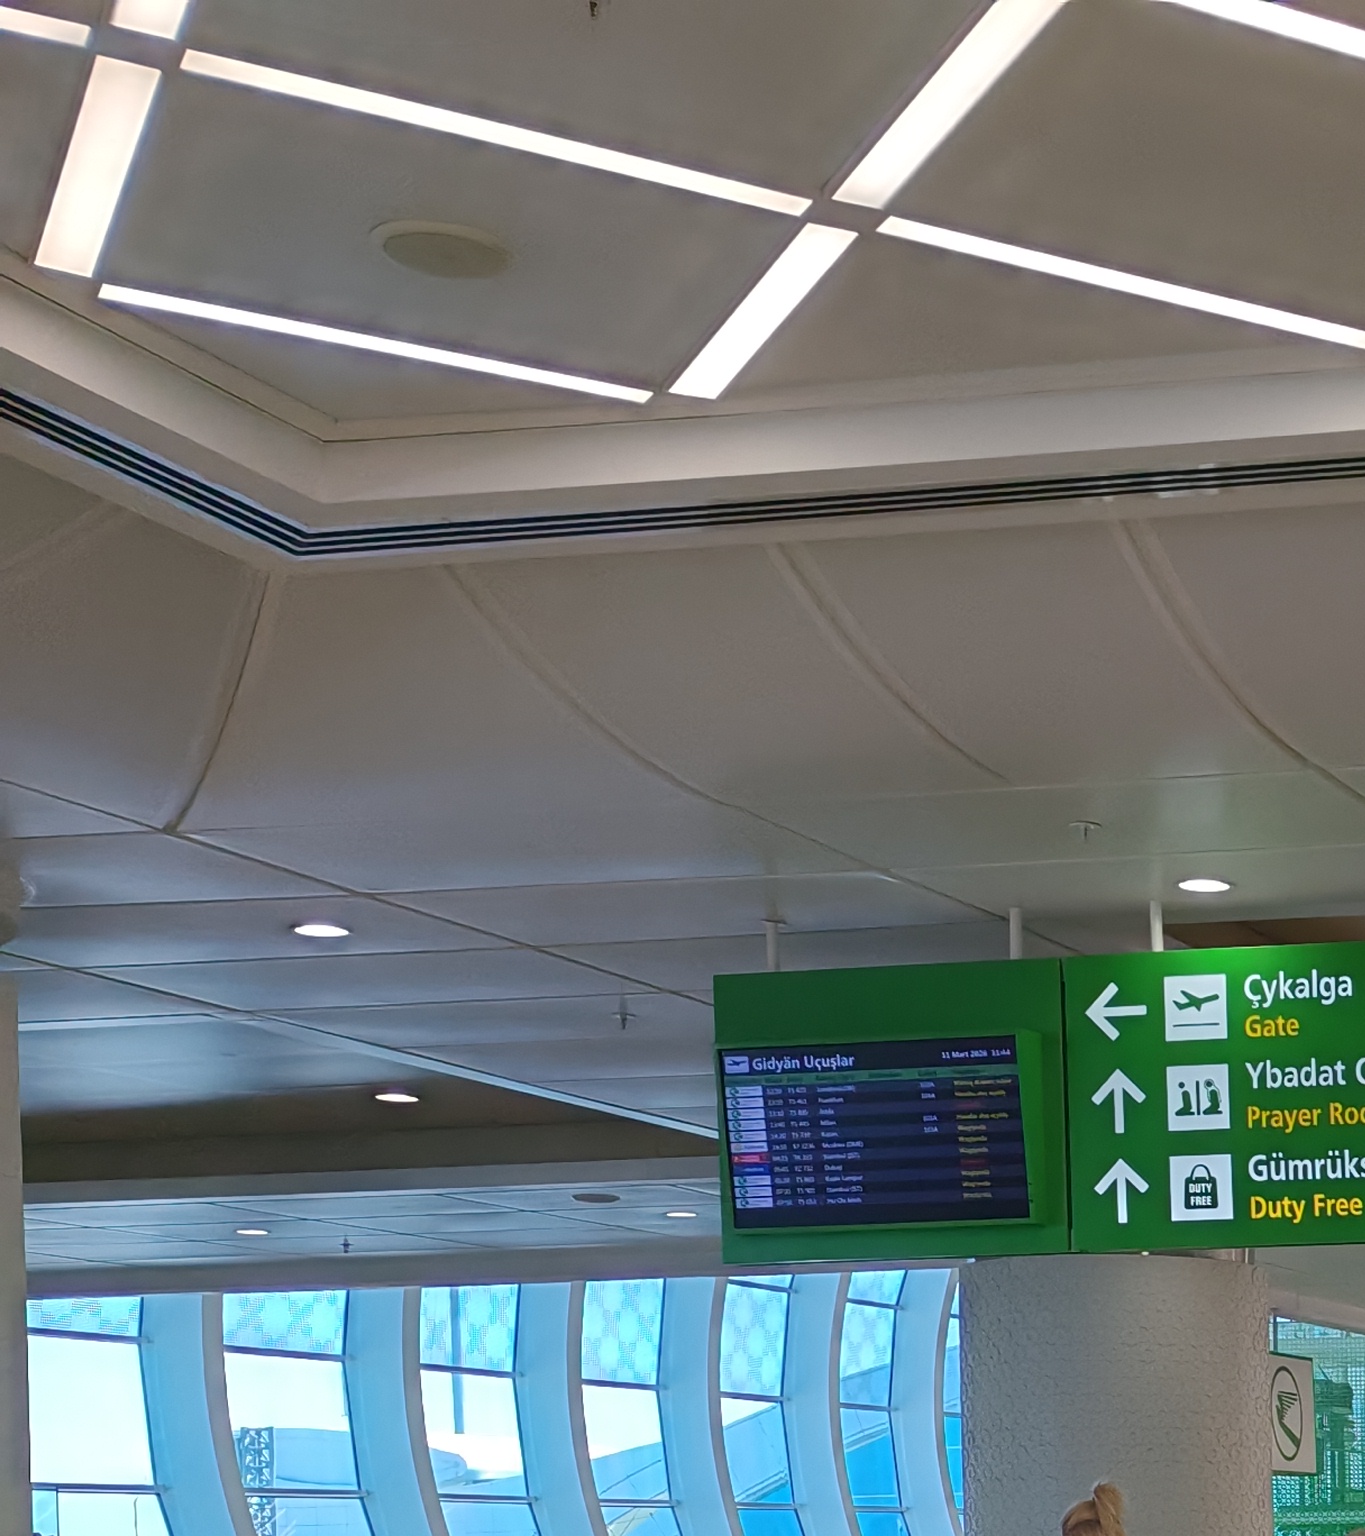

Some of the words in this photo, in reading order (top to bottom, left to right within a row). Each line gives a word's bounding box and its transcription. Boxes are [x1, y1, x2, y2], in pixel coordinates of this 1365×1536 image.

[1244, 969, 1352, 1008] Çykalga
[1245, 1015, 1299, 1037] Gate
[753, 1057, 799, 1072] Gidyän
[804, 1055, 853, 1070] Uçuşlar
[1246, 1058, 1346, 1088] Ybadat
[1248, 1107, 1320, 1133] Prayer
[1188, 1183, 1212, 1193] DUTY
[1190, 1196, 1212, 1206] FREE
[1251, 1197, 1305, 1223] Duty
[1314, 1194, 1362, 1216] Free
